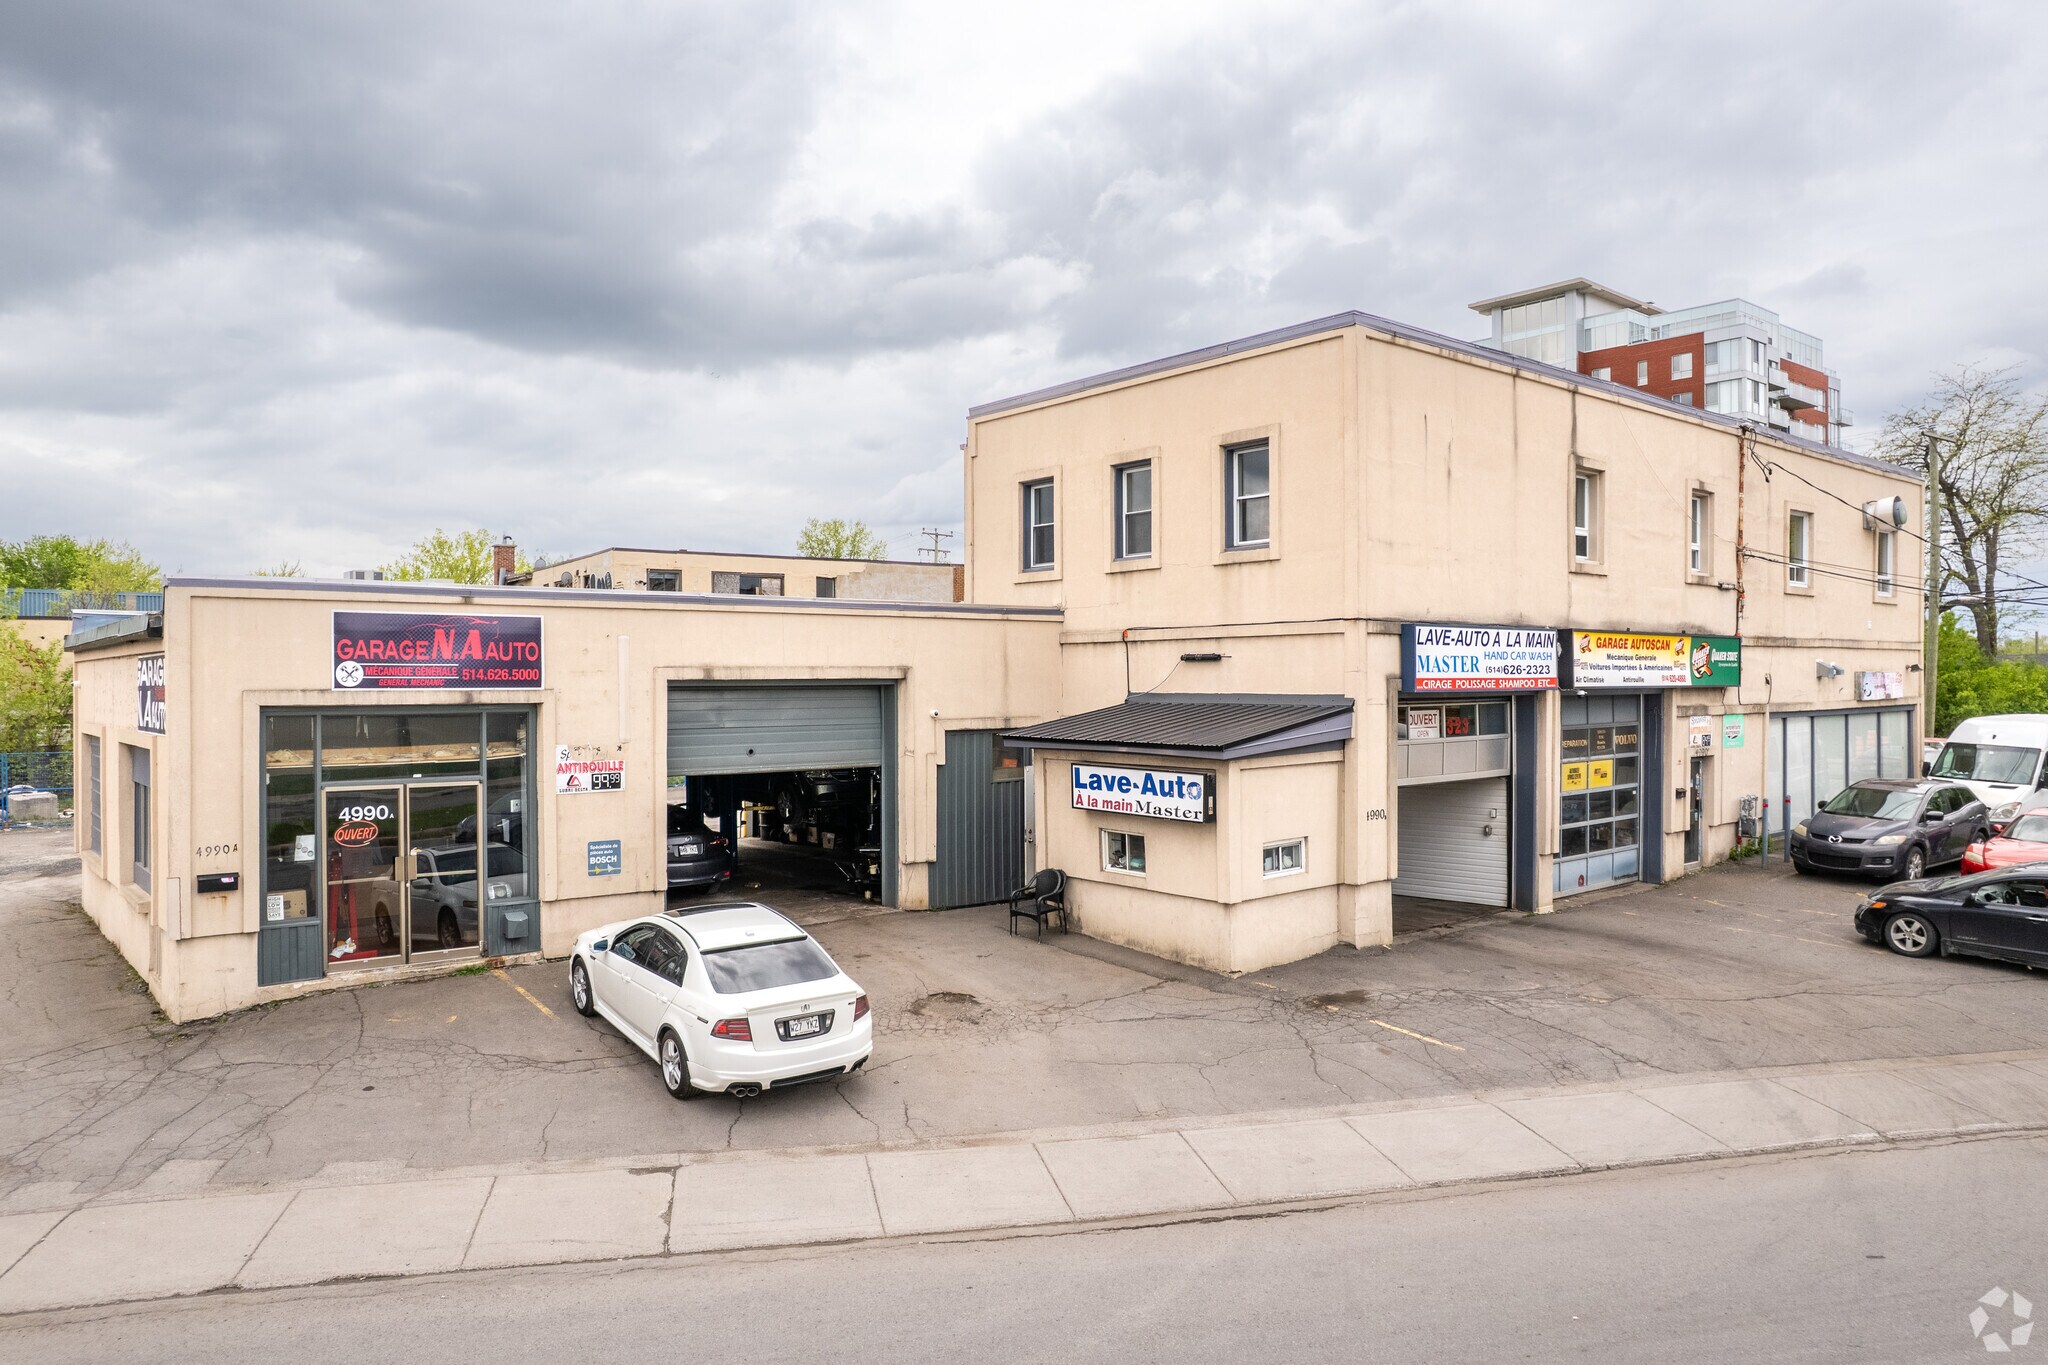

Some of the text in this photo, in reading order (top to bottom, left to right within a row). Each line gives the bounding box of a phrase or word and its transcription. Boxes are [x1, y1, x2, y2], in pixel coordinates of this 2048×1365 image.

[336, 628, 540, 662] GARAGE N.A AUTO
[1416, 628, 1490, 647] LAVE-AUTO
[1506, 631, 1522, 648] LA
[1525, 632, 1555, 649] MAIN
[1595, 636, 1671, 651] GARAGE AUTOSCAN
[1483, 650, 1553, 661] HAND CAR WASH
[1416, 654, 1480, 673] MASTER
[1588, 663, 1611, 671] Voitures
[364, 664, 414, 677] MÉCANIQUE
[461, 668, 540, 681] 514.626.5000
[378, 678, 446, 687] GENERAL MECHANIC
[1455, 679, 1496, 689] POLISSAGE
[1498, 679, 1536, 688] SHAMPOO
[1416, 730, 1430, 738] OPEN
[1614, 733, 1638, 746] VOLVO
[556, 760, 624, 775] ANTIROUILLE
[1074, 766, 1203, 801] Lave-Auto
[1075, 789, 1203, 820] À la main Master
[336, 826, 375, 841] OUVERT
[589, 855, 618, 865] BOSCH
